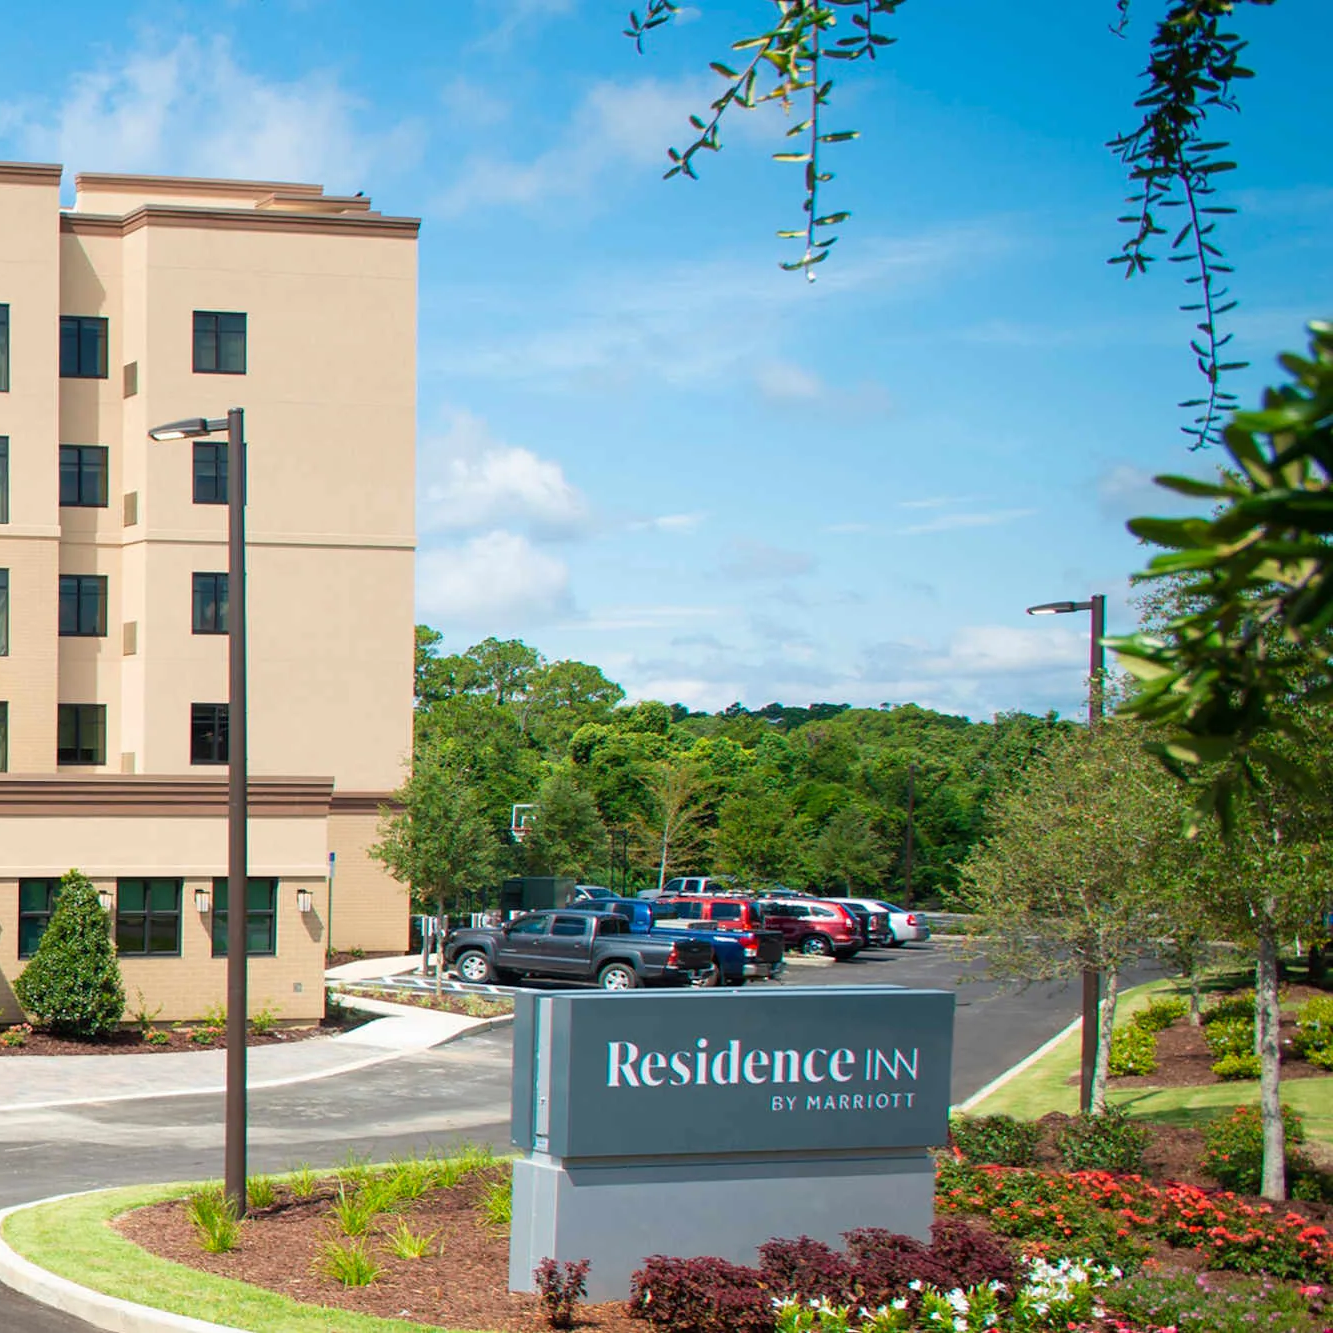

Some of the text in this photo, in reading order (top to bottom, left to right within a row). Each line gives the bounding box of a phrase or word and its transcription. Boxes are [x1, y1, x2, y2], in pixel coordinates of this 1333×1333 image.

[606, 1037, 919, 1088] Residence INN
[771, 1092, 917, 1111] BY MARRIOTT
